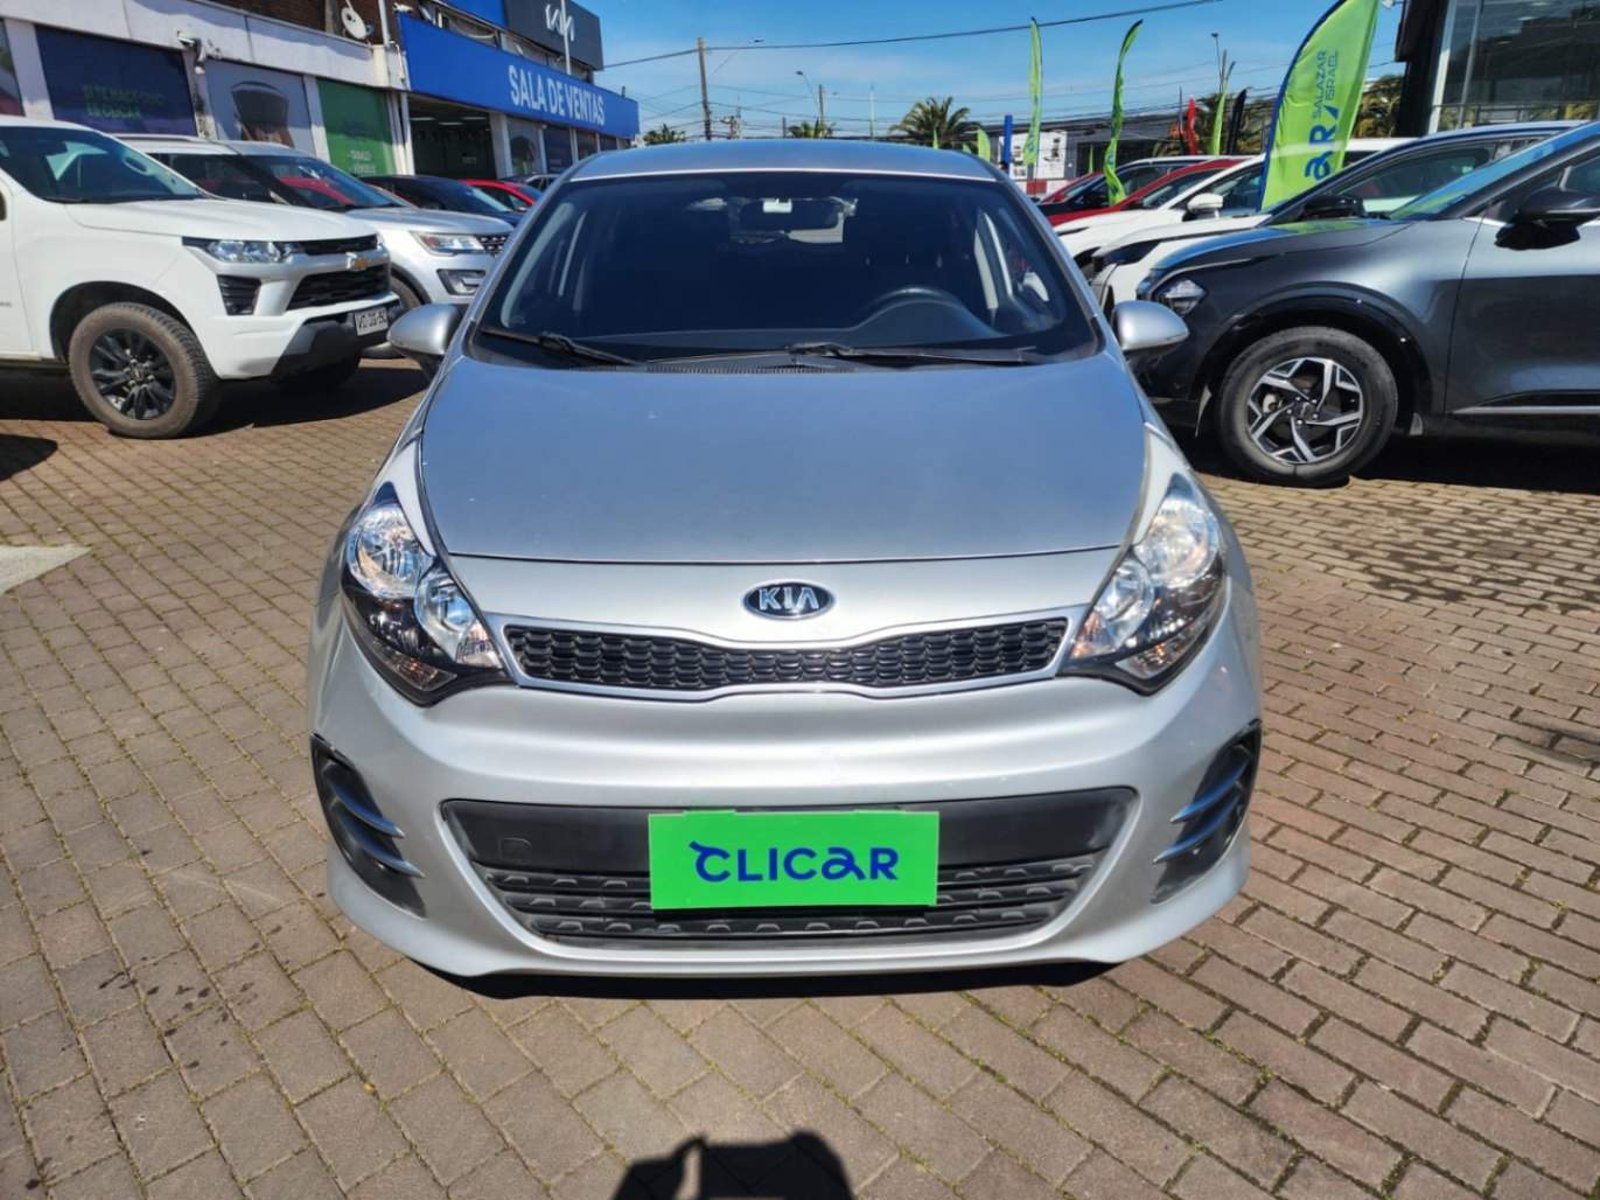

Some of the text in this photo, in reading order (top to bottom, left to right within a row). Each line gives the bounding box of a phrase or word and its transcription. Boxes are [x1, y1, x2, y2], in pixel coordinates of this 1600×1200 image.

[509, 65, 606, 126] SALA DE VENTAS
[1313, 50, 1325, 119] SALAZAR
[1325, 50, 1339, 101] ISRAEL
[759, 586, 820, 610] KIA
